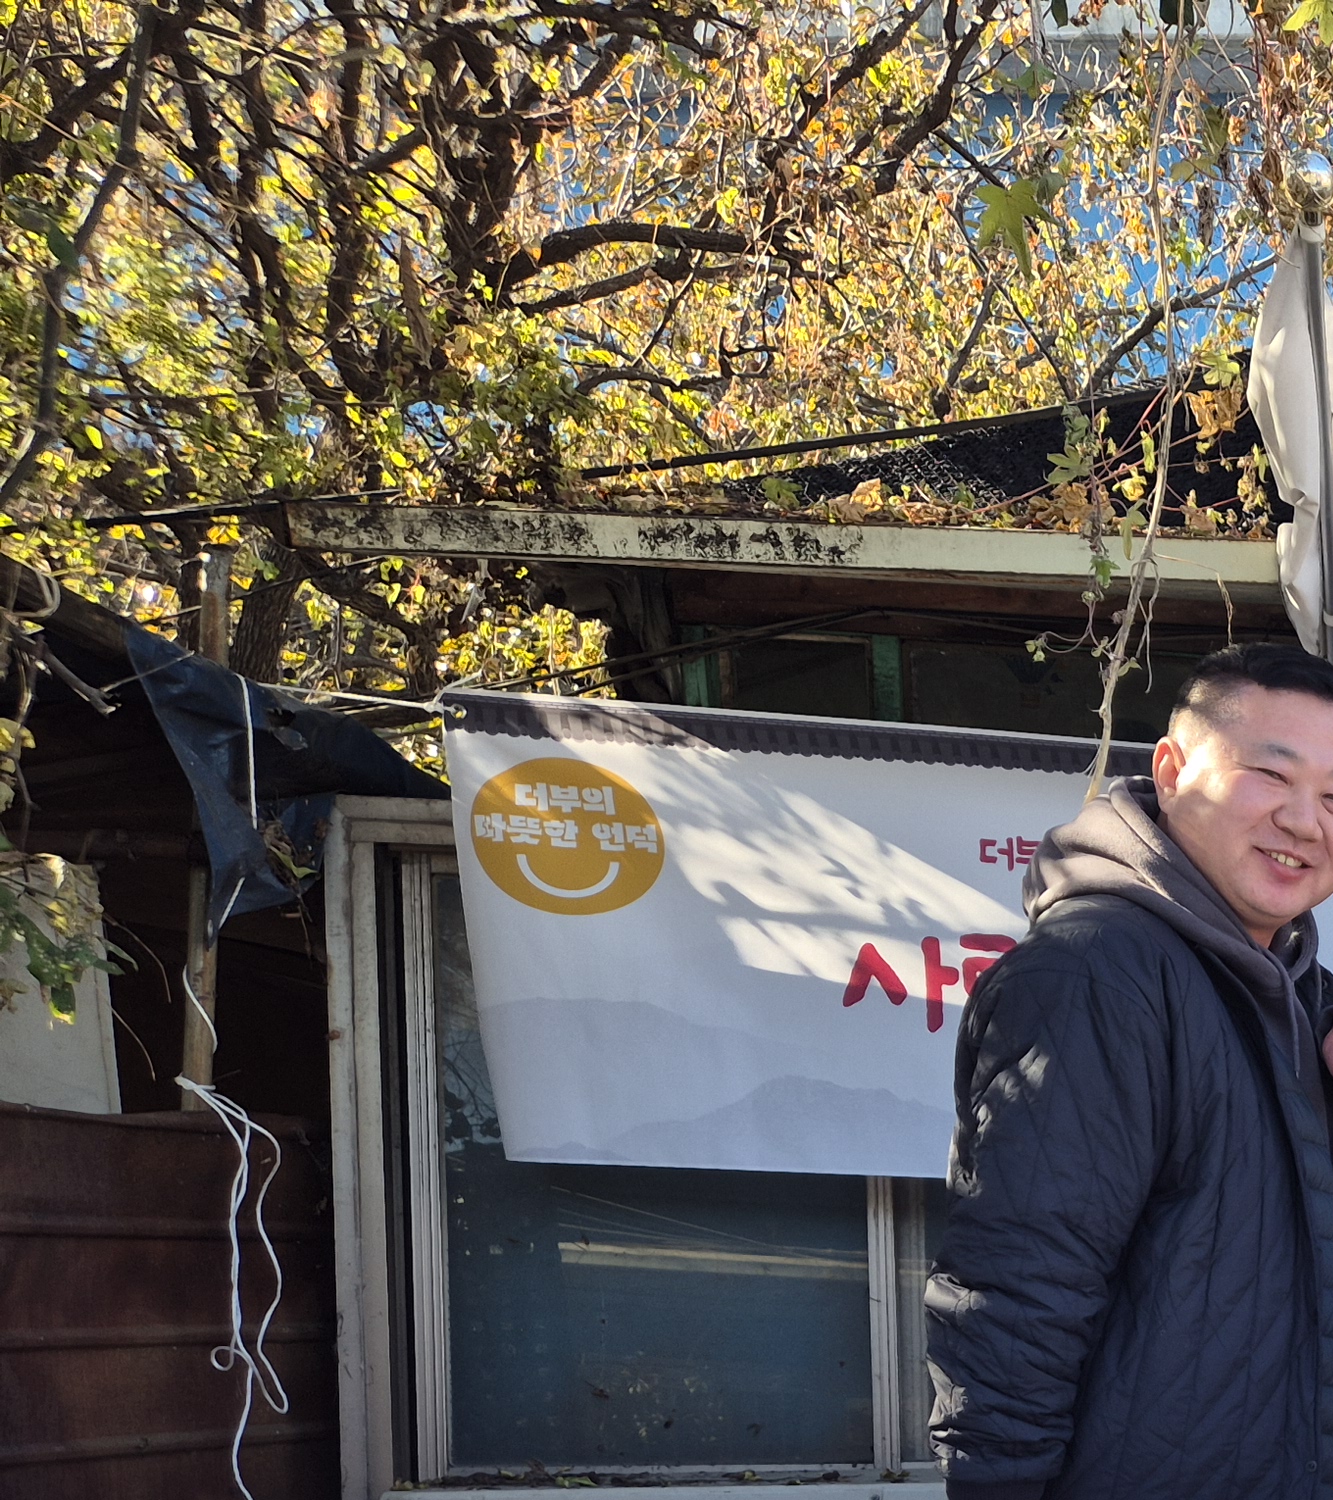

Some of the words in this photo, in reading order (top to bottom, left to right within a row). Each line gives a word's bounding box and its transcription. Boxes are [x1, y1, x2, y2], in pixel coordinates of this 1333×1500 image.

[514, 782, 616, 815] 더부의
[473, 812, 579, 848] 따뜻한
[591, 821, 658, 854] 언덕
